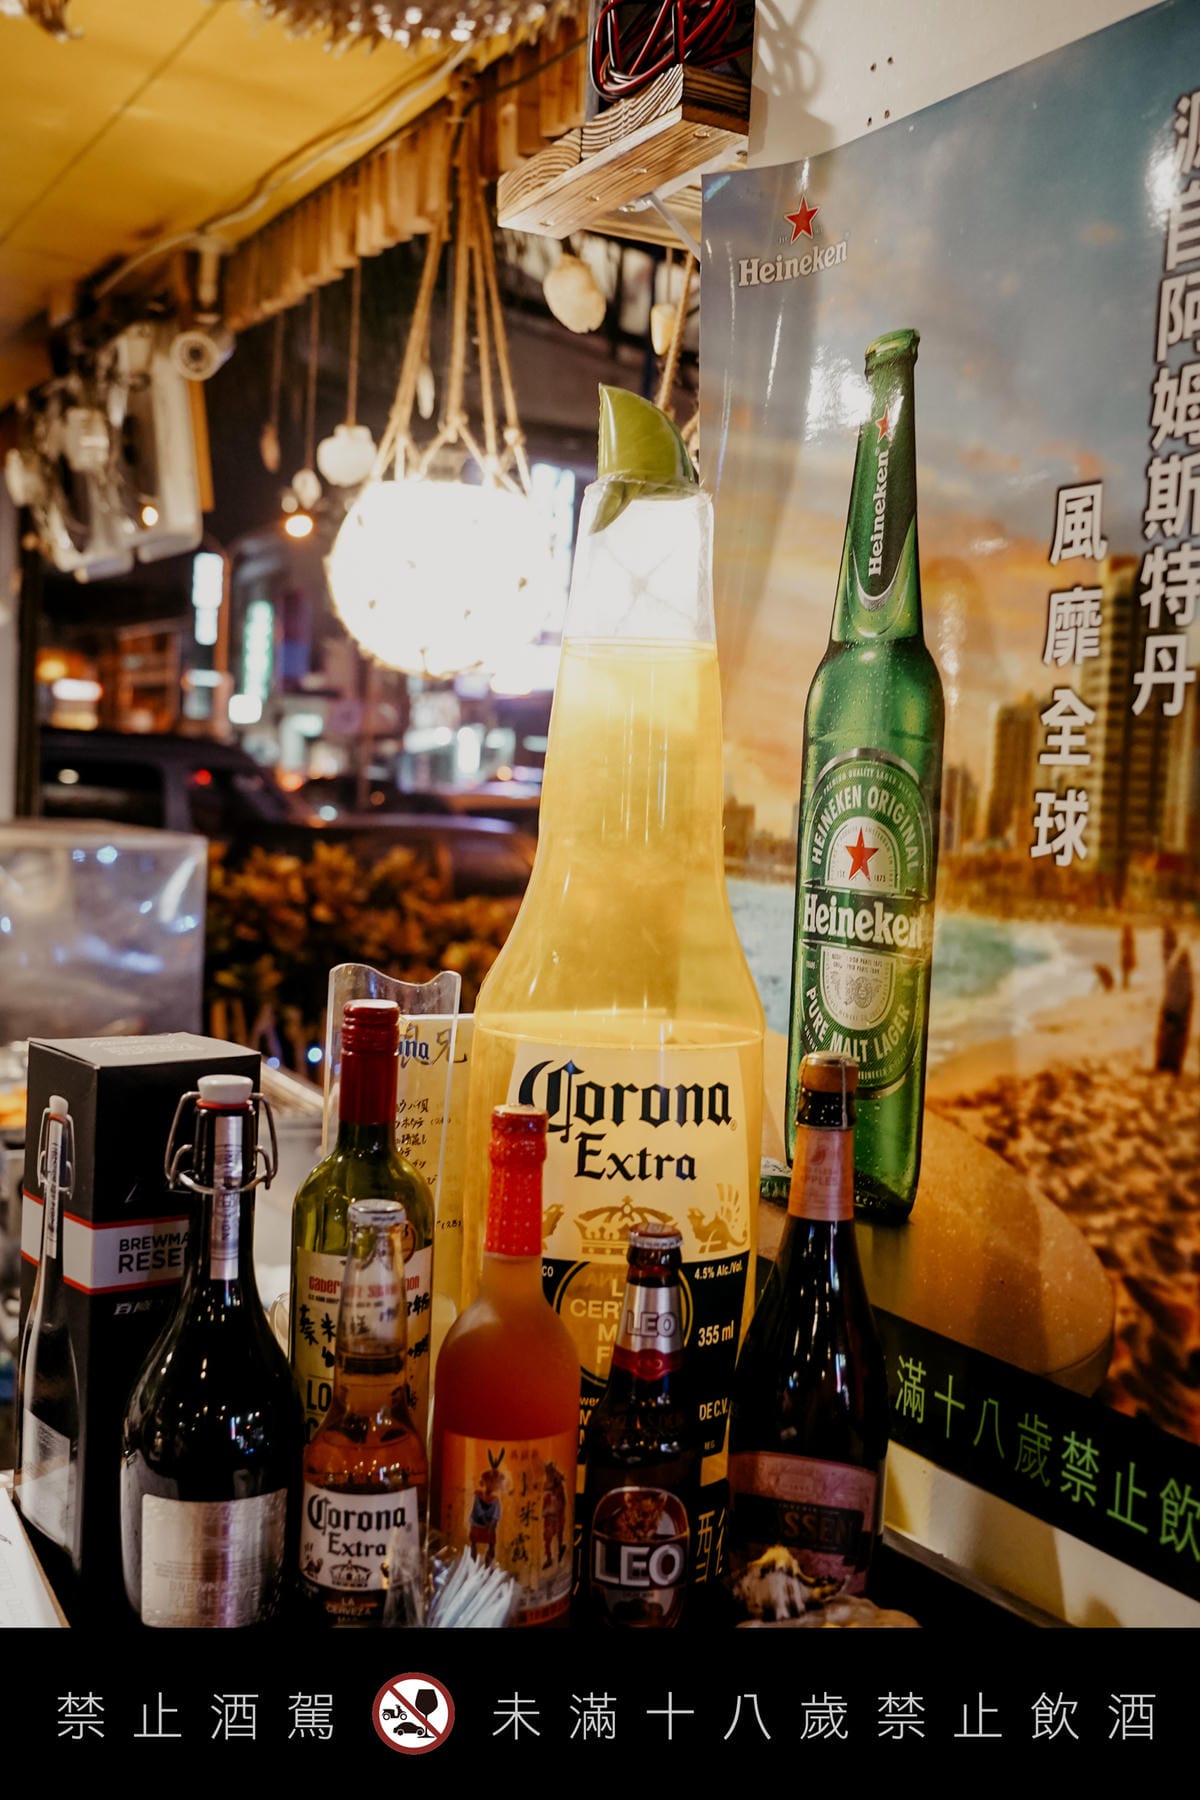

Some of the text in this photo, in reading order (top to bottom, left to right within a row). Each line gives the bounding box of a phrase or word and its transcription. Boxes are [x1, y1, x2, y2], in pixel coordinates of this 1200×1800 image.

[739, 241, 848, 287] Heineken
[868, 449, 889, 577] Heineken
[1030, 482, 1108, 867] 風靡全球
[811, 784, 862, 866] HEINEKEN
[866, 785, 919, 873] ORIGINAL
[803, 892, 923, 949] Heineken
[806, 986, 829, 1044] PURE
[829, 1030, 869, 1063] MALT
[873, 1003, 911, 1061] LAGER
[518, 1059, 733, 1144] Corona
[574, 1131, 698, 1181] Extra
[118, 1247, 182, 1275] RESE
[119, 1231, 190, 1252] BREWMA
[694, 1258, 744, 1280] 4.5% Alc./Vol.
[626, 1310, 677, 1338] LEO
[697, 1319, 735, 1348] 355 ml
[894, 1354, 1200, 1562] 滿十八歲禁止飲
[307, 1494, 406, 1536] Corona
[327, 1532, 387, 1558] Extra
[594, 1539, 684, 1587] LEO
